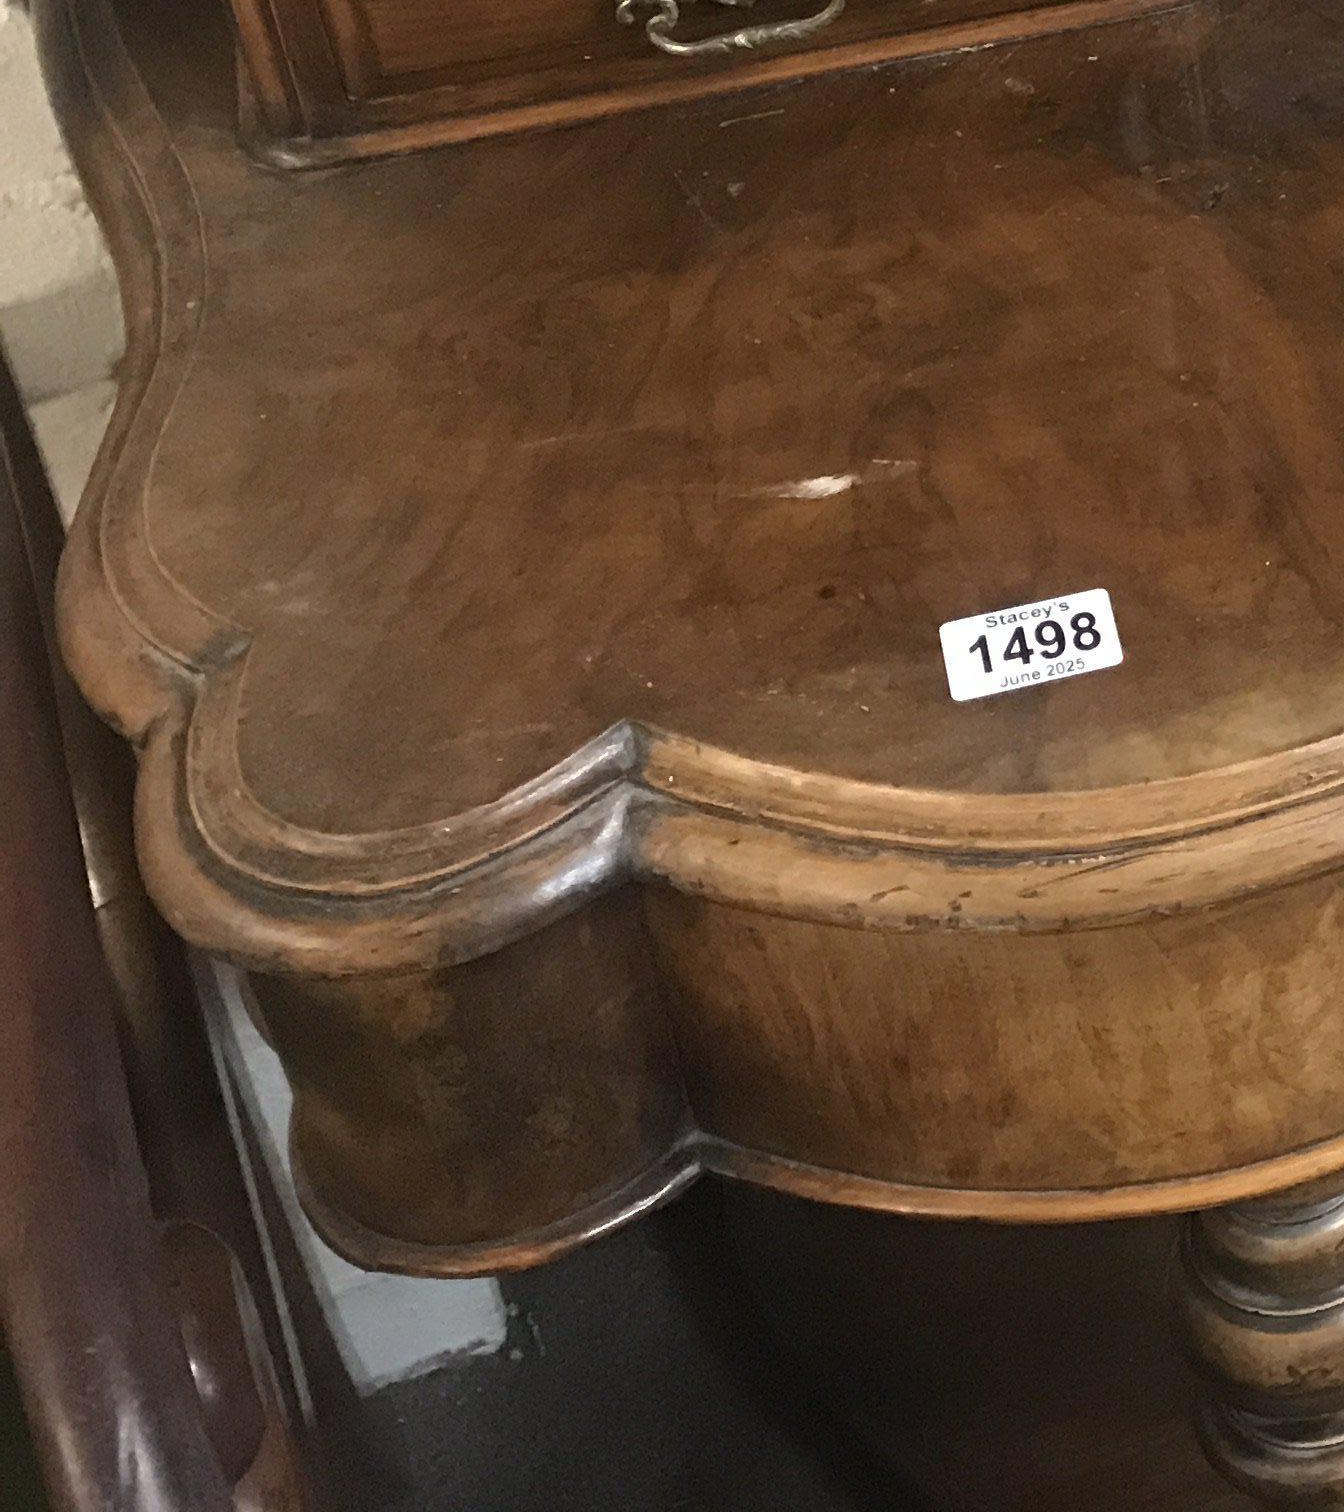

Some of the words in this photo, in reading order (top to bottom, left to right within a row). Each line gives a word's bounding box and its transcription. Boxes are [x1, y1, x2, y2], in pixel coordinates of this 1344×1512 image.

[985, 601, 1070, 628] Stacey's
[968, 611, 1102, 674] 1498
[1000, 670, 1041, 688] June
[1046, 657, 1085, 677] 2025
